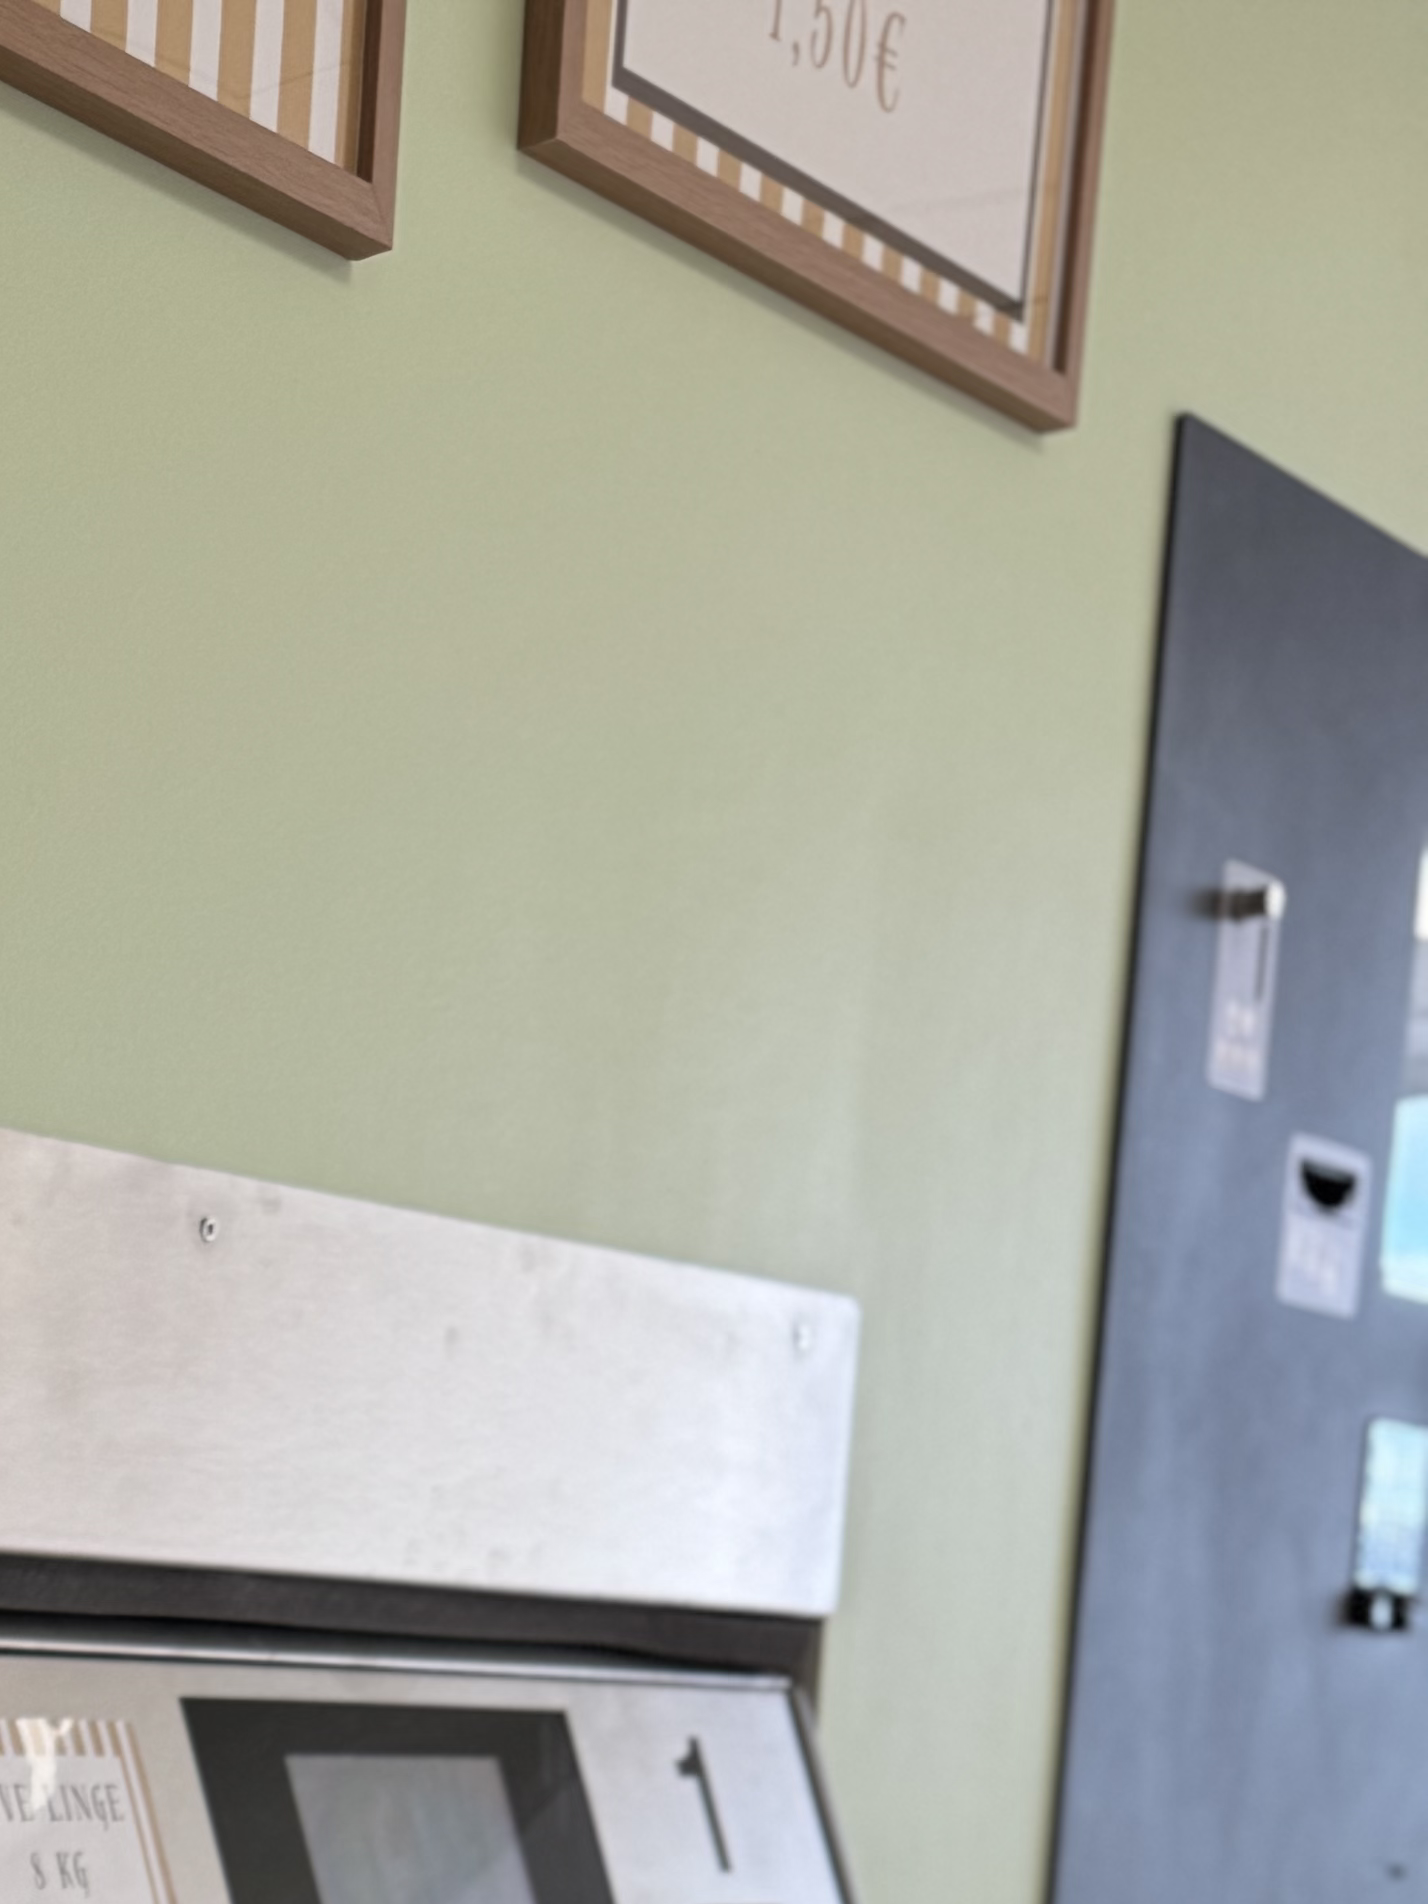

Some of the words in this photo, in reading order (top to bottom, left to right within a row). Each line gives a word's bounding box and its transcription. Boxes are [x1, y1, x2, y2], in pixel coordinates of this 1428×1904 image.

[46, 1783, 125, 1831] LINGE
[675, 1735, 732, 1872] 1
[29, 1851, 46, 1890] 8
[55, 1850, 90, 1899] KG
